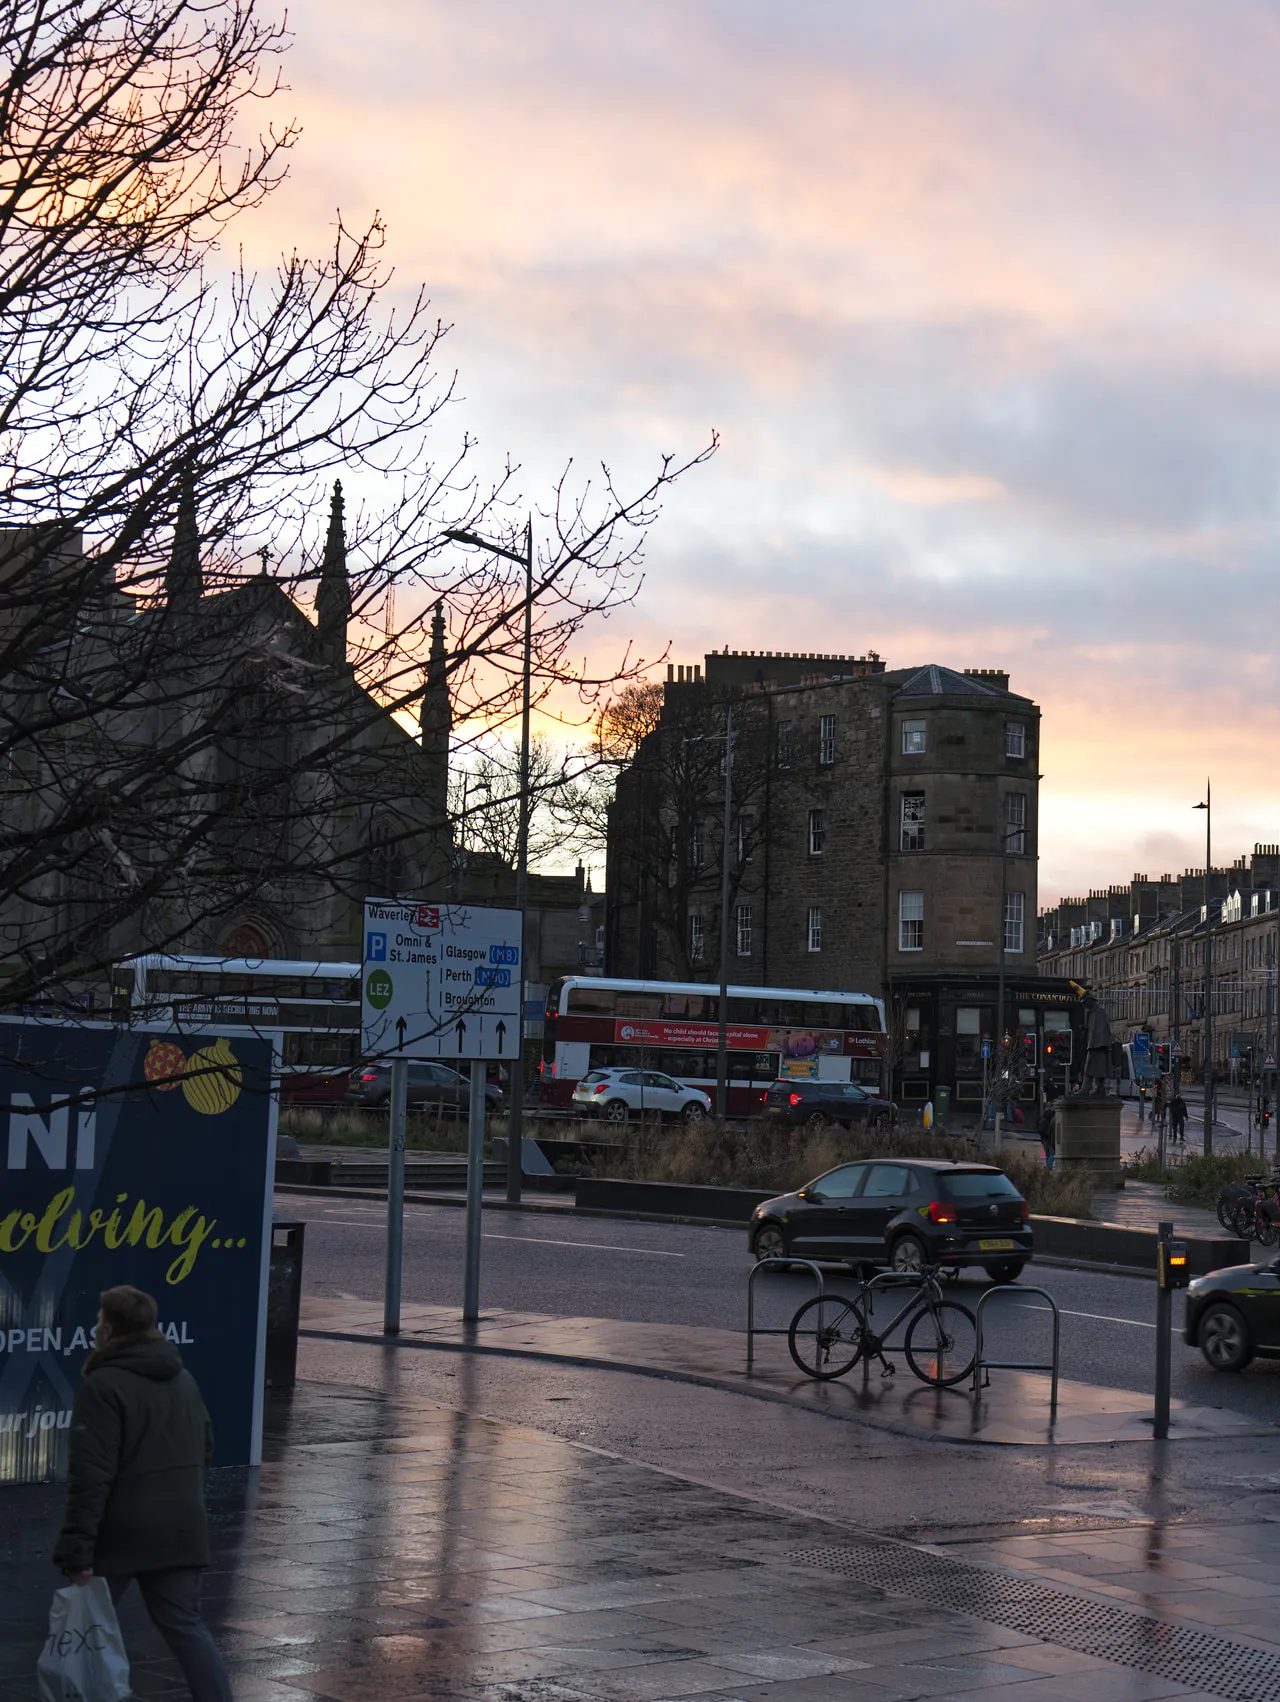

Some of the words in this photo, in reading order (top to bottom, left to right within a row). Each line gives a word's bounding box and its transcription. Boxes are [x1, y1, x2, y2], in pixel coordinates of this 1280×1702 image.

[368, 906, 418, 924] Waverley
[373, 935, 384, 958] P
[395, 933, 423, 948] Omni
[424, 936, 432, 948] &
[389, 949, 405, 963] St.
[406, 950, 437, 965] James
[446, 945, 487, 962] Glasgow
[490, 948, 518, 963] (M8)
[445, 969, 472, 983] Perth
[370, 983, 390, 996] LEZ
[445, 994, 496, 1010] Broughton
[192, 1003, 213, 1013] ARMY
[261, 1006, 279, 1016] NOW
[687, 1028, 706, 1036] should
[855, 1037, 877, 1045] Lothian
[1170, 1257, 1185, 1265] WAIT
